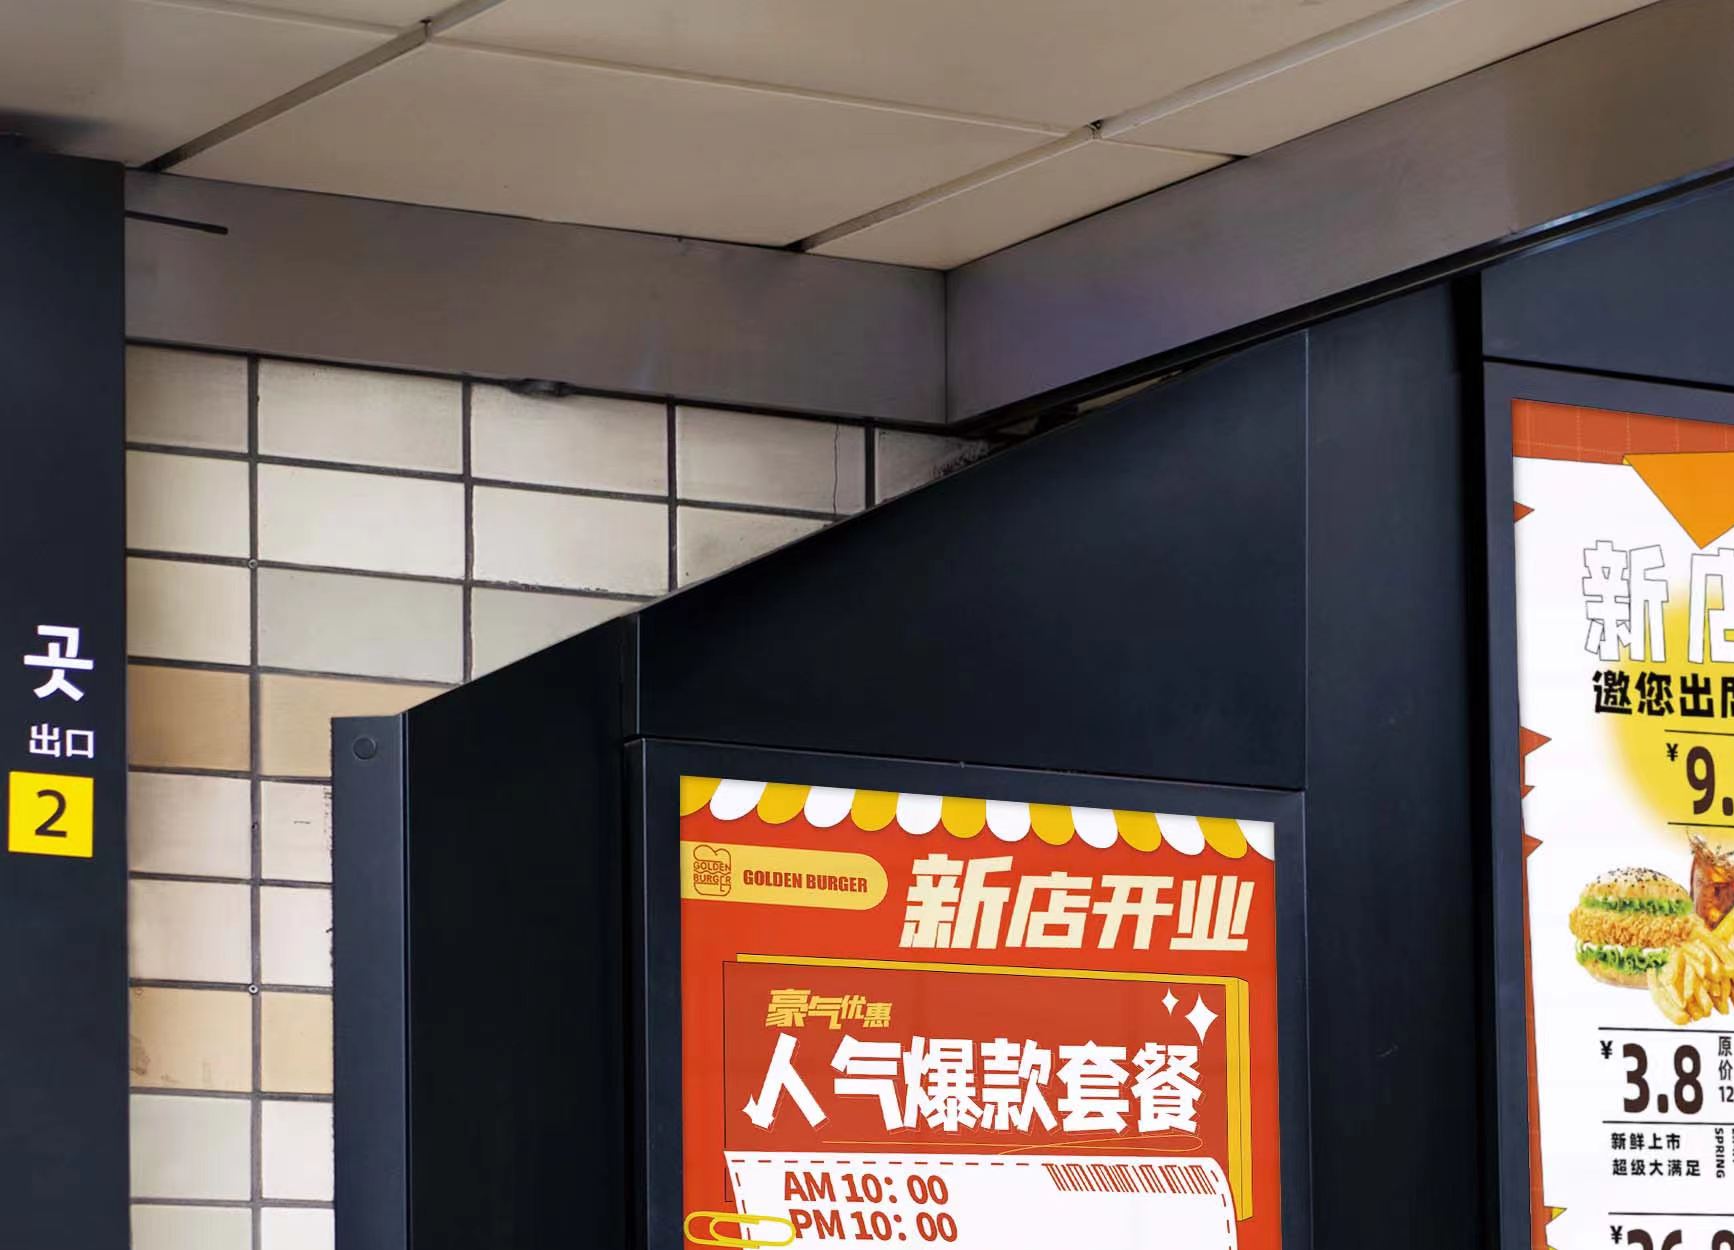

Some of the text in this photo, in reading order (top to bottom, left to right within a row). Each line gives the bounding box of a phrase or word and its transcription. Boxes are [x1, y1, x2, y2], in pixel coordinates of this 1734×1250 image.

[23, 624, 94, 702] 곳
[28, 723, 95, 759] 出口
[34, 788, 68, 838] 2
[743, 869, 868, 893] GOLDEN BURGER
[899, 852, 1255, 951] 新店开业
[765, 988, 893, 1030] 豪气优惠
[743, 1032, 1203, 1134] 人气爆款套餐
[1611, 1133, 1681, 1152] 新鲜上市
[1714, 1127, 1726, 1179] SPRING
[784, 1171, 836, 1203] AM
[1612, 1157, 1702, 1179] 超级大满足
[791, 1208, 847, 1241] PM
